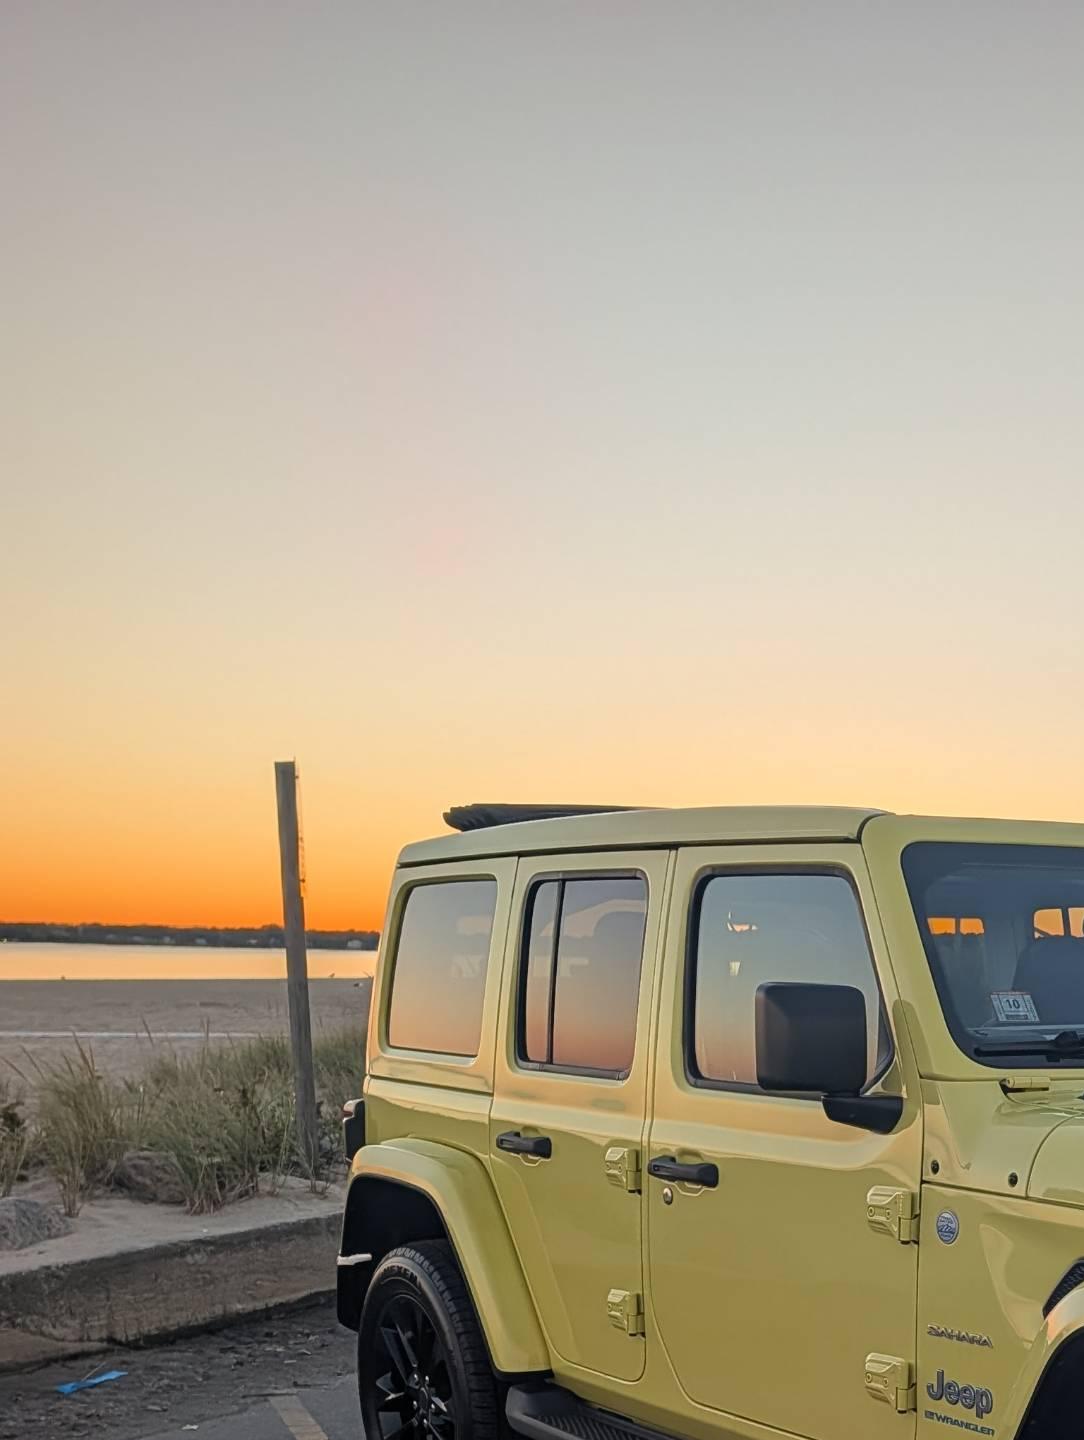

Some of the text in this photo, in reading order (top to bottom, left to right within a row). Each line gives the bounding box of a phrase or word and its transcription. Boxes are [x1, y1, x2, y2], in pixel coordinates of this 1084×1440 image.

[1006, 999, 1020, 1009] 10
[927, 1325, 993, 1348] SAHARA
[927, 1369, 993, 1419] Jeep
[934, 1412, 995, 1436] WRANGLER
